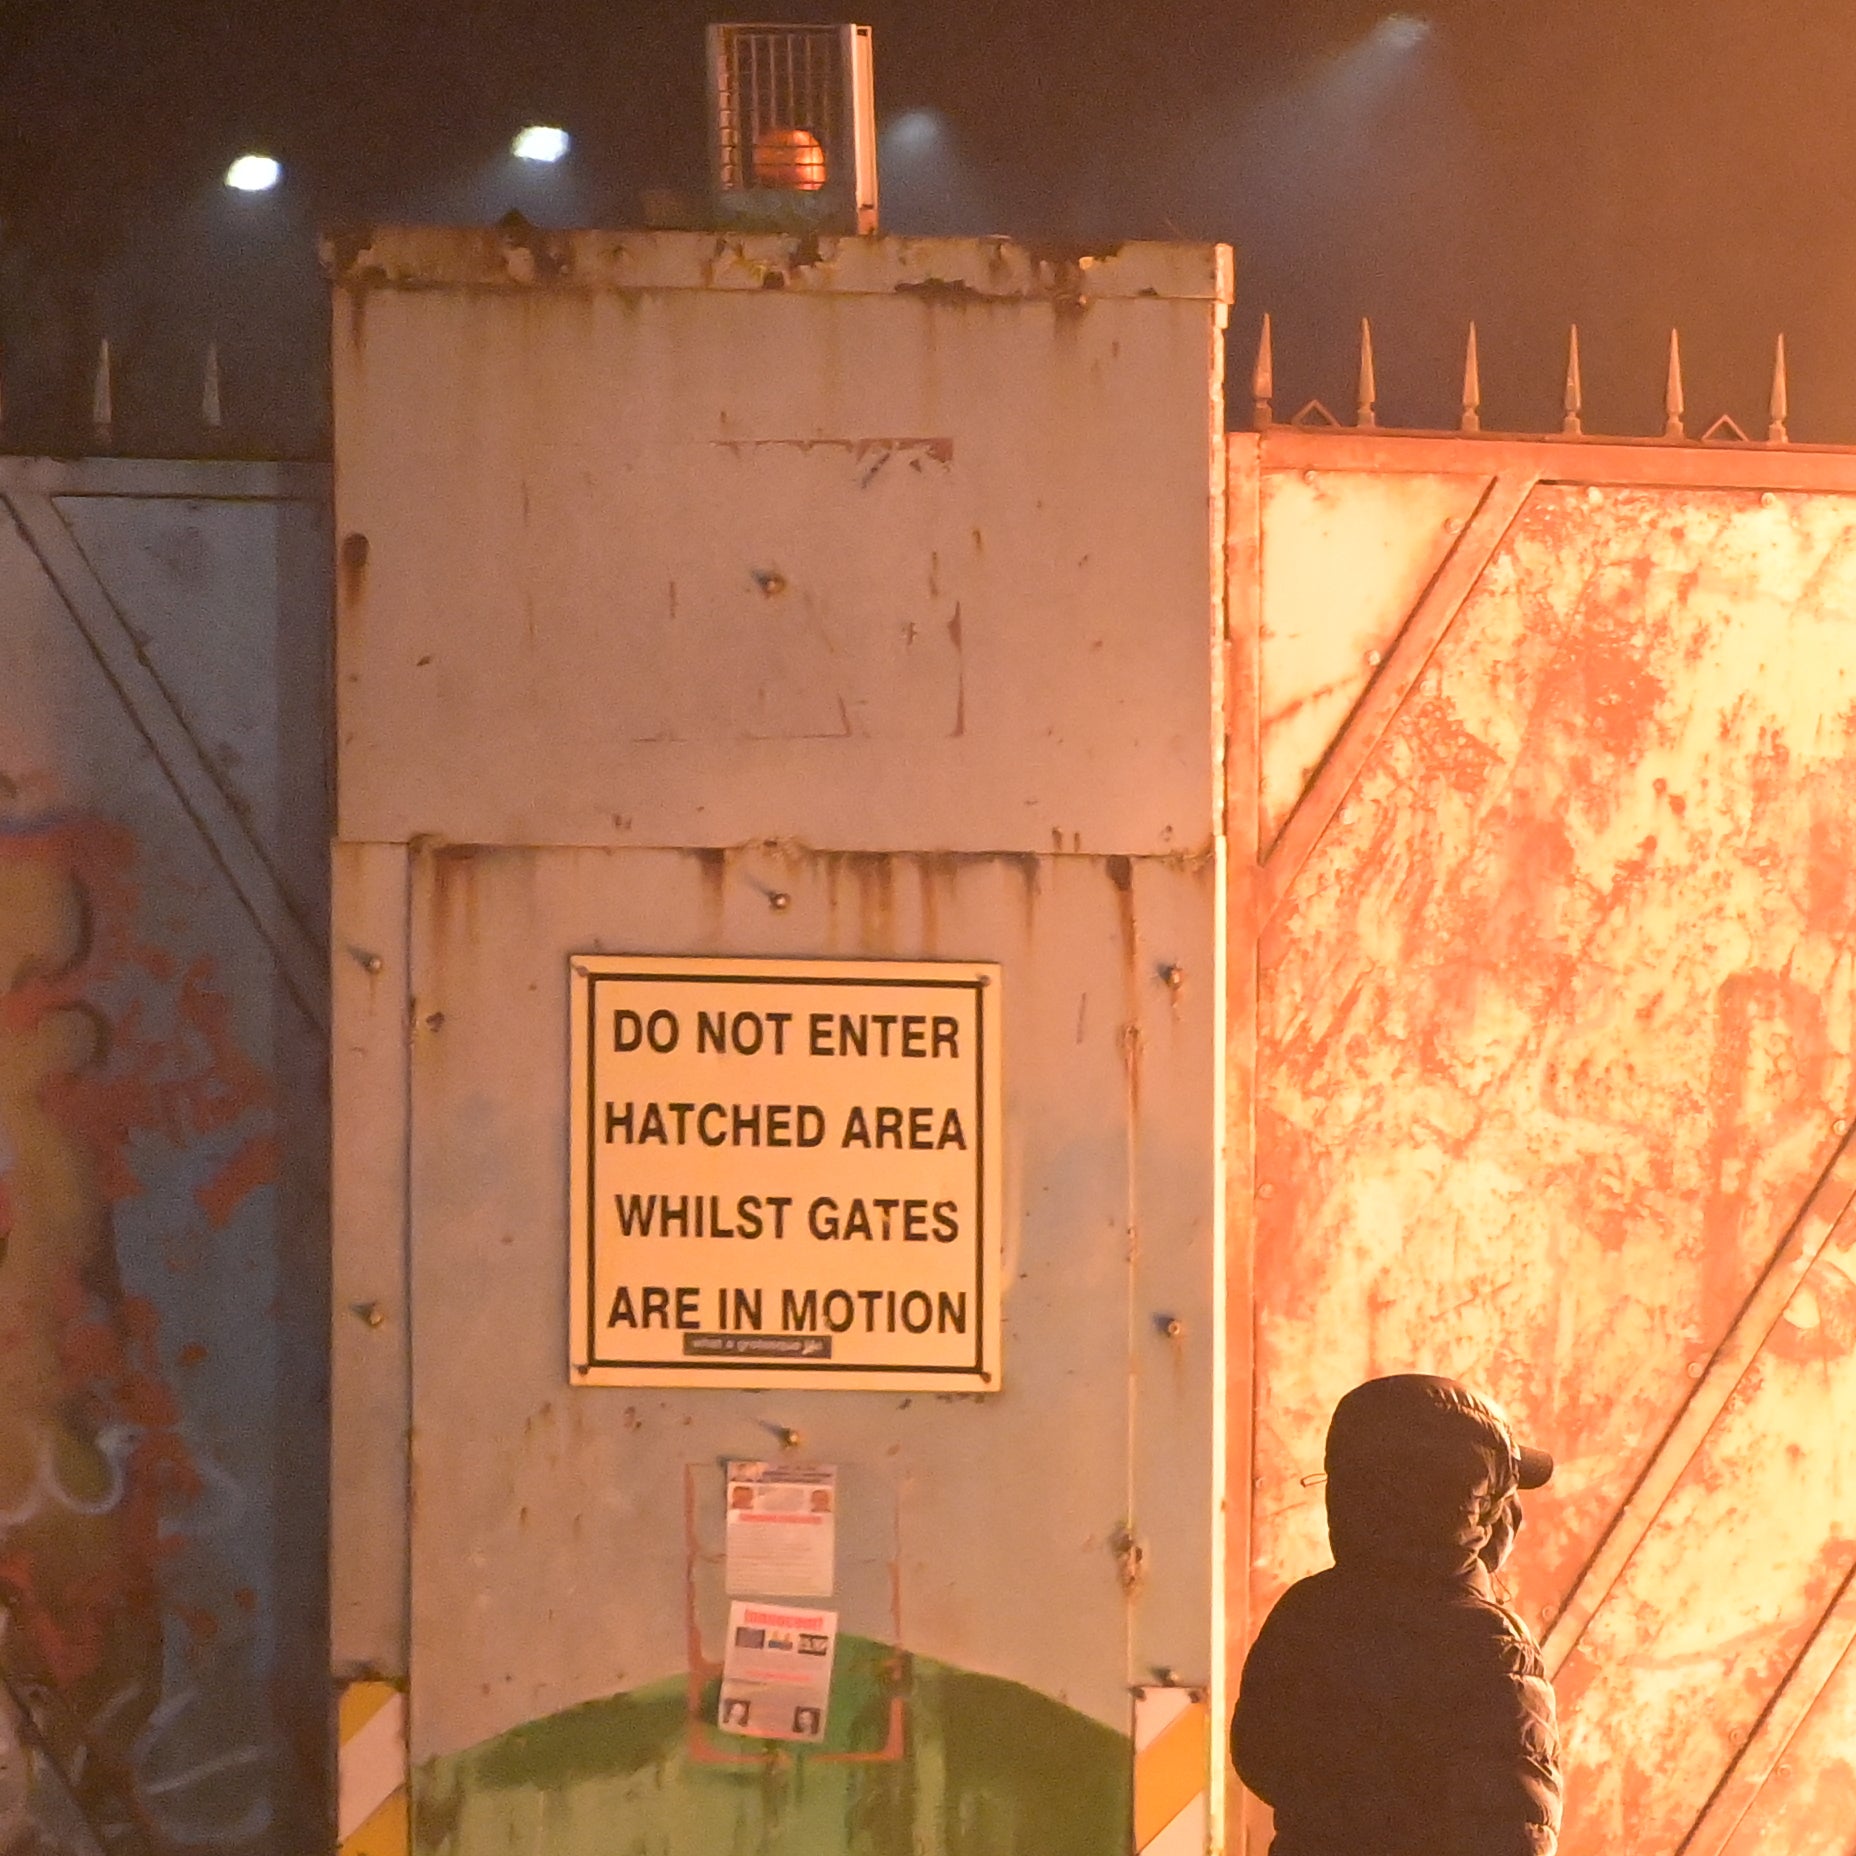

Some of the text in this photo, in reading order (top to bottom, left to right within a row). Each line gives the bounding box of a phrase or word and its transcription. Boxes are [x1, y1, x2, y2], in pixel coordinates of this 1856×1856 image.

[613, 1009, 960, 1059] DO NOT ENTER
[604, 1101, 967, 1151] HATCHED AREA
[614, 1193, 960, 1244] WHILST GATES
[607, 1286, 968, 1335] ARE IN MOTION
